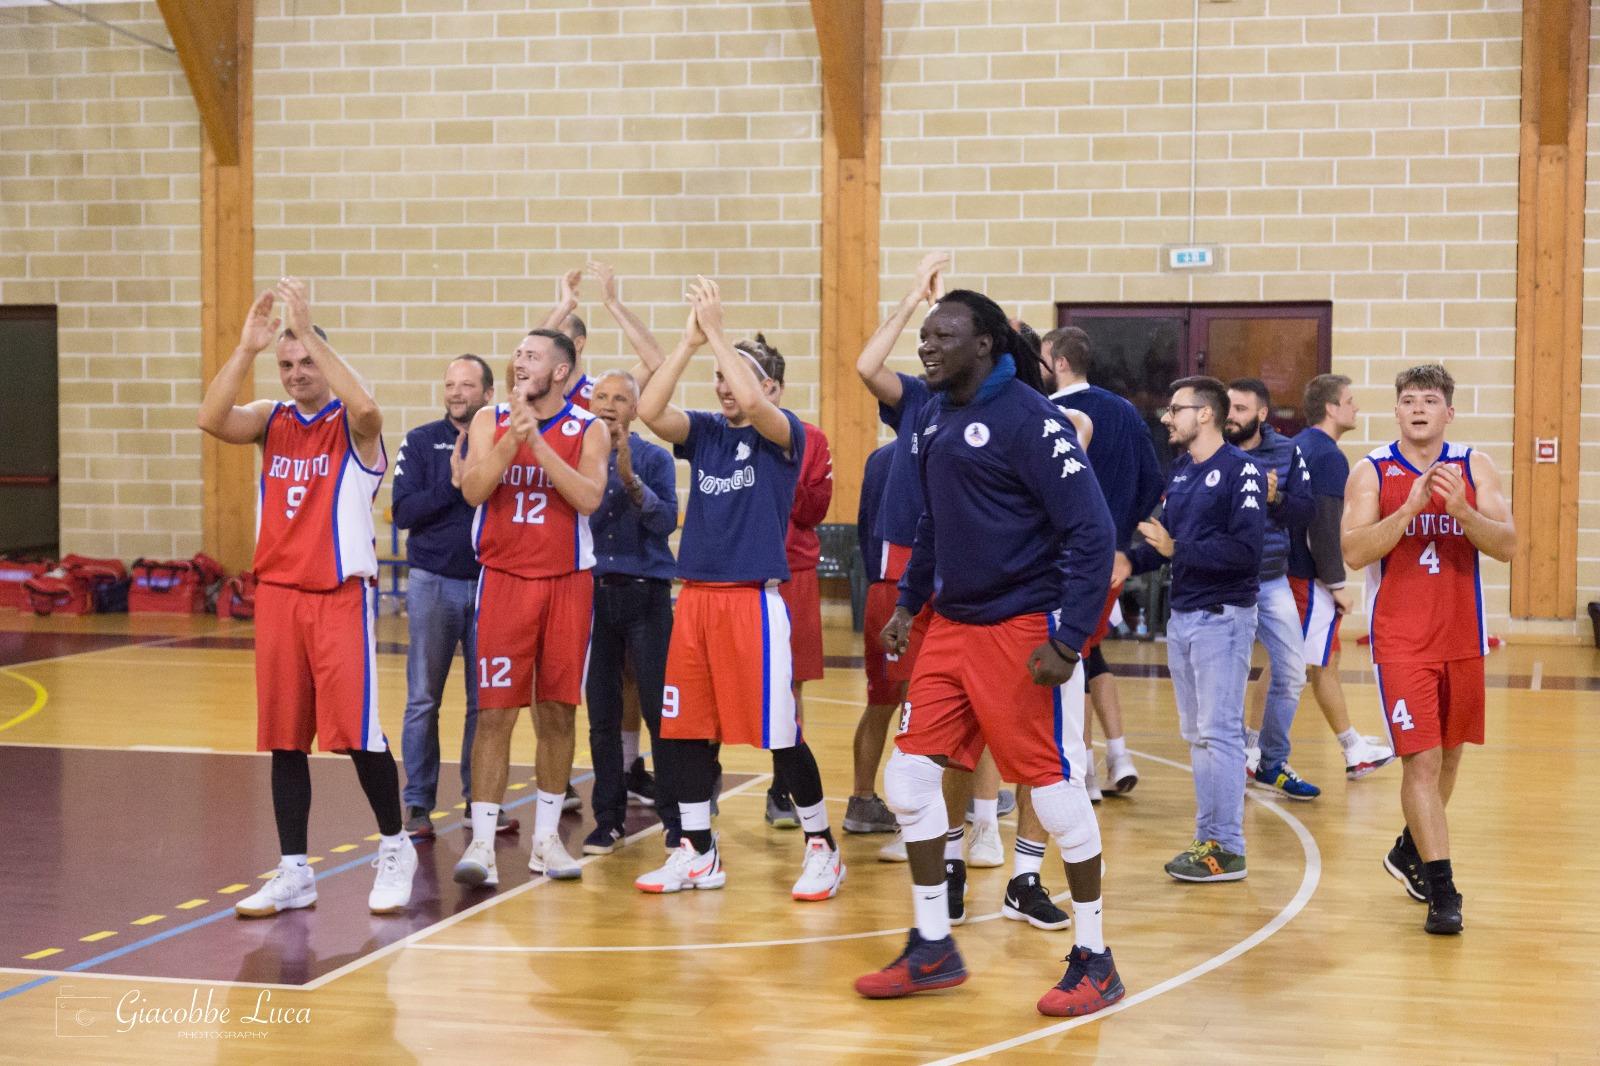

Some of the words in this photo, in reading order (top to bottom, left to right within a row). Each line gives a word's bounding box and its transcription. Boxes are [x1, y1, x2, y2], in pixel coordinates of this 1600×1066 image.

[512, 491, 547, 525] 12
[1419, 540, 1440, 575] 4
[479, 656, 512, 689] 12
[661, 685, 680, 719] 9
[1391, 698, 1415, 731] 4
